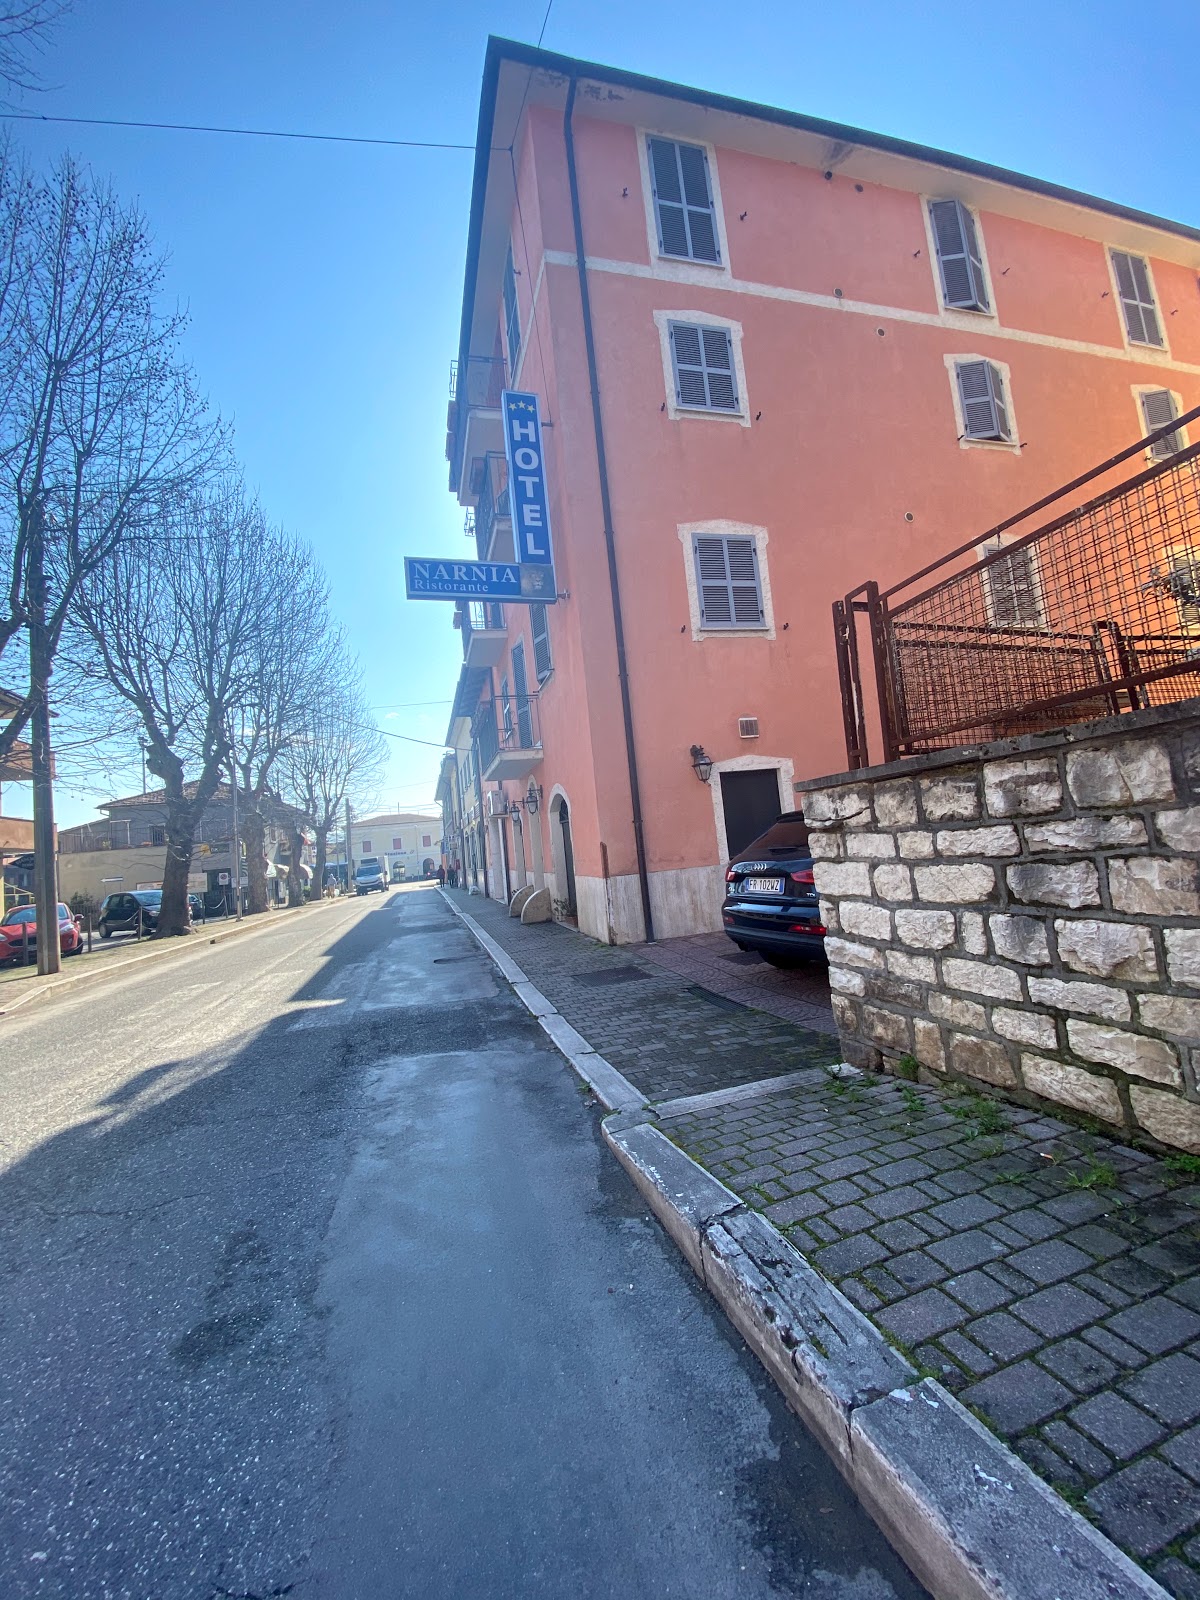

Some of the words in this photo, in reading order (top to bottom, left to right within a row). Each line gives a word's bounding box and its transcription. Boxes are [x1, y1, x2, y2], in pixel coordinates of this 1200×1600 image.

[512, 419, 545, 556] HOTEL
[413, 563, 518, 583] NARNIA
[415, 579, 489, 592] Ristorante
[750, 880, 757, 890] FR
